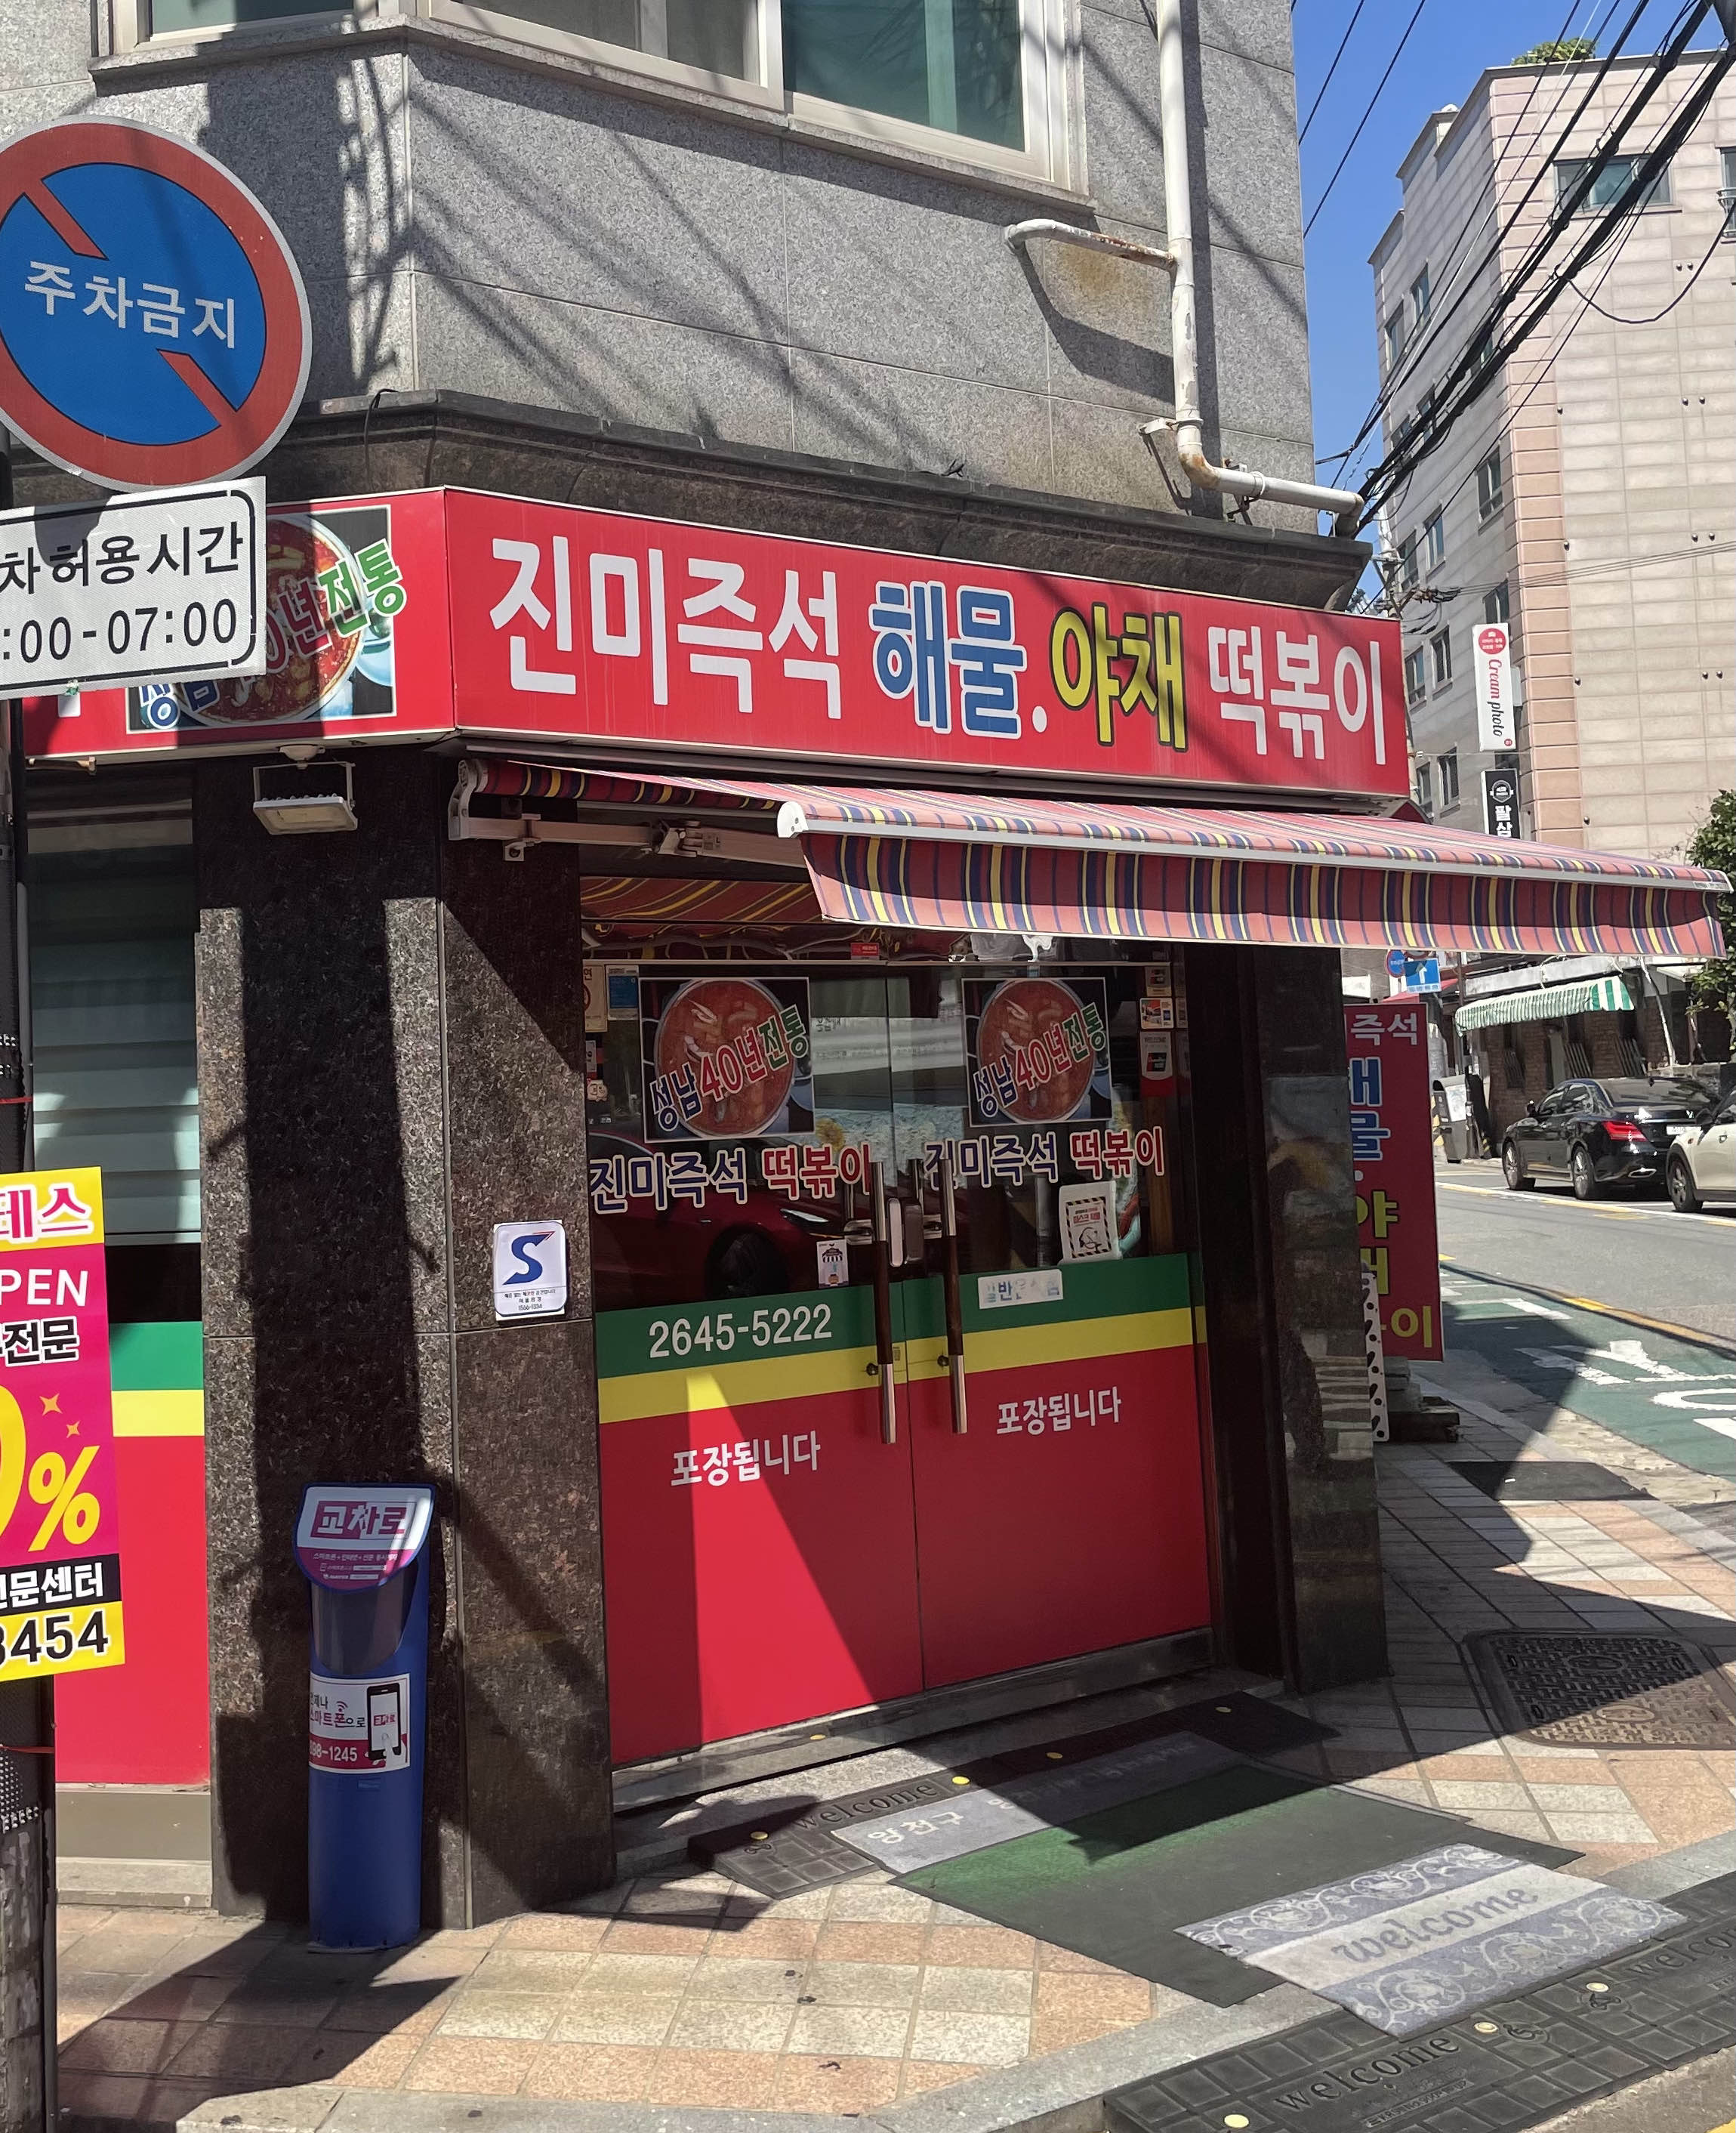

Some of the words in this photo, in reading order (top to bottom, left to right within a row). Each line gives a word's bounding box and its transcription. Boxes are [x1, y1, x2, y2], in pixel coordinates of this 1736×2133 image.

[24, 260, 236, 349] 주차금지
[489, 536, 842, 721] 진미즉석
[1207, 625, 1386, 766] 떡볶이
[1488, 659, 1502, 699] Cream
[1487, 701, 1505, 737] photo
[589, 1147, 748, 1215] 진미즉석
[762, 1142, 871, 1201] 떡볶이
[924, 1131, 1059, 1191] 진미즉석
[1069, 1127, 1165, 1180] 떡볶이
[648, 1303, 833, 1359] 2645-5222
[996, 1386, 1122, 1437] 포장됩니다
[671, 1430, 822, 1487] 포장됩니다
[316, 1505, 408, 1536] 교차로
[791, 1780, 937, 1831] welcome
[867, 1810, 965, 1844] 양천구
[1331, 1884, 1539, 1964] welcome
[1274, 2036, 1460, 2111] welcome
